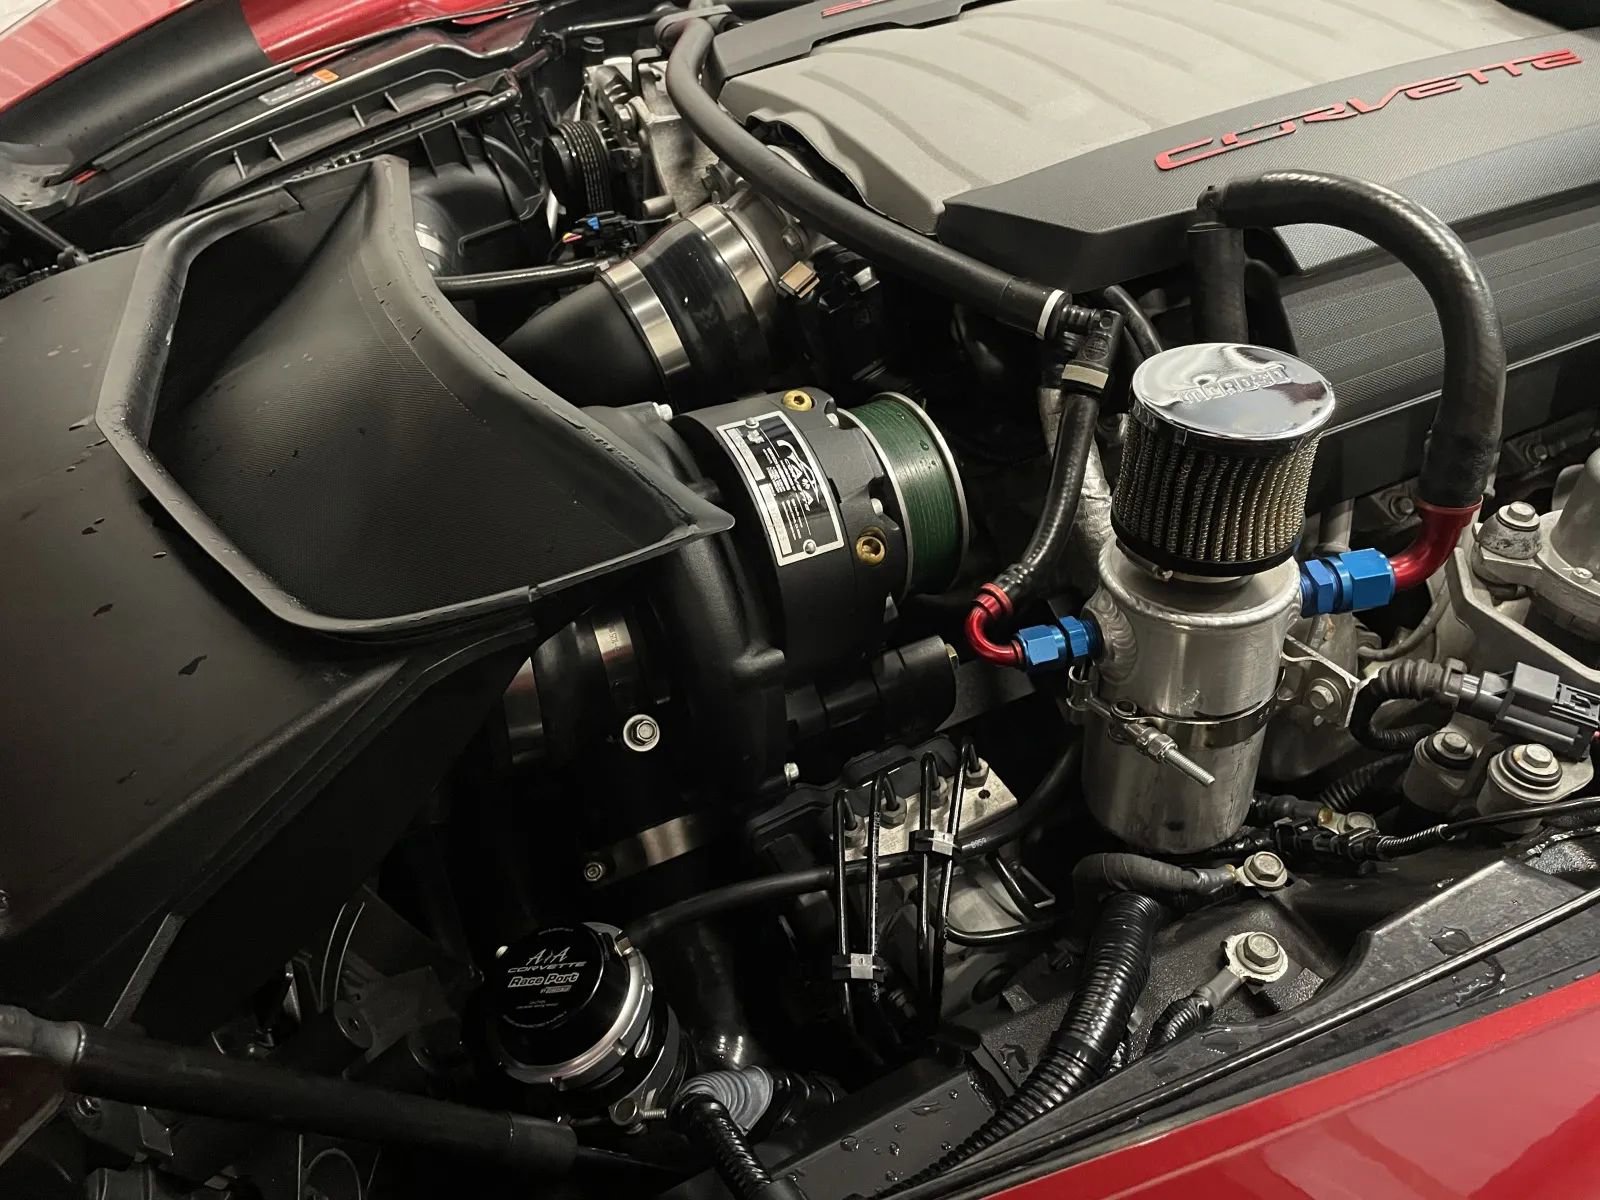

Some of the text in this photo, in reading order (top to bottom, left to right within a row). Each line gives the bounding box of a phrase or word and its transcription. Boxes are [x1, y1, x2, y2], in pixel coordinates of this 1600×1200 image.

[1154, 47, 1584, 171] CORVETTE
[508, 961, 587, 973] CORVETTE
[507, 972, 580, 988] Race Port
